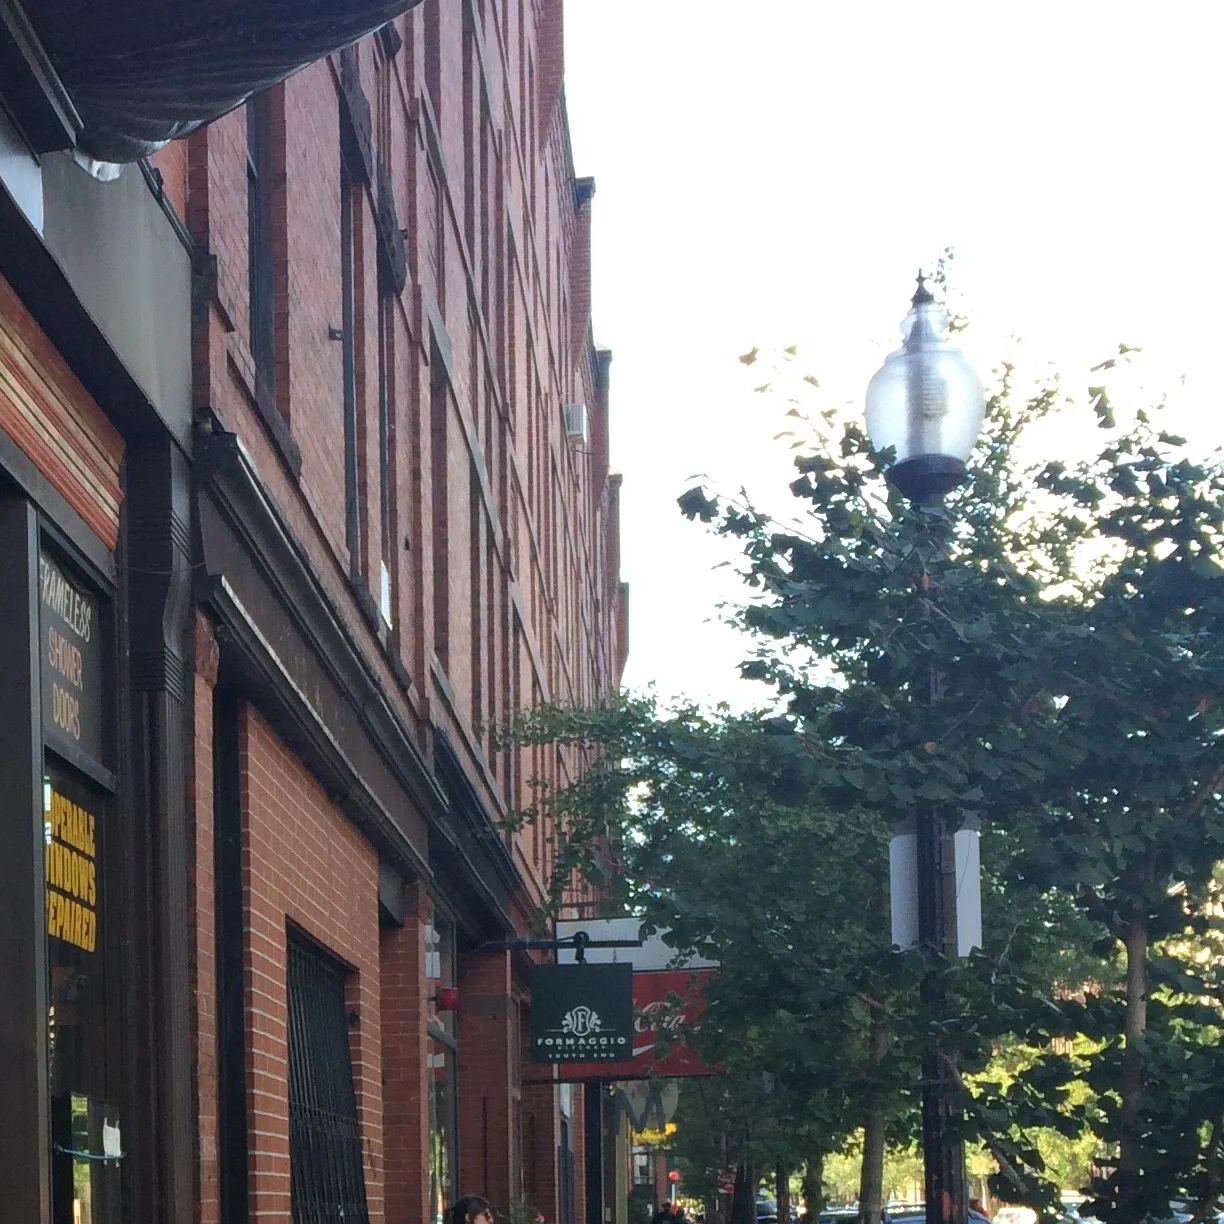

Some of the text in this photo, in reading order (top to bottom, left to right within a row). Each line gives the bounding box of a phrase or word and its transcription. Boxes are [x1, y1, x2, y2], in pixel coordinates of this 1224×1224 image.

[48, 625, 84, 690] SHOWER
[52, 682, 81, 740] DOORS
[45, 789, 96, 858] PERABLE
[46, 841, 96, 906] INDOWS
[46, 890, 97, 953] EPAIRED
[537, 1036, 627, 1046] FORMAGGIO
